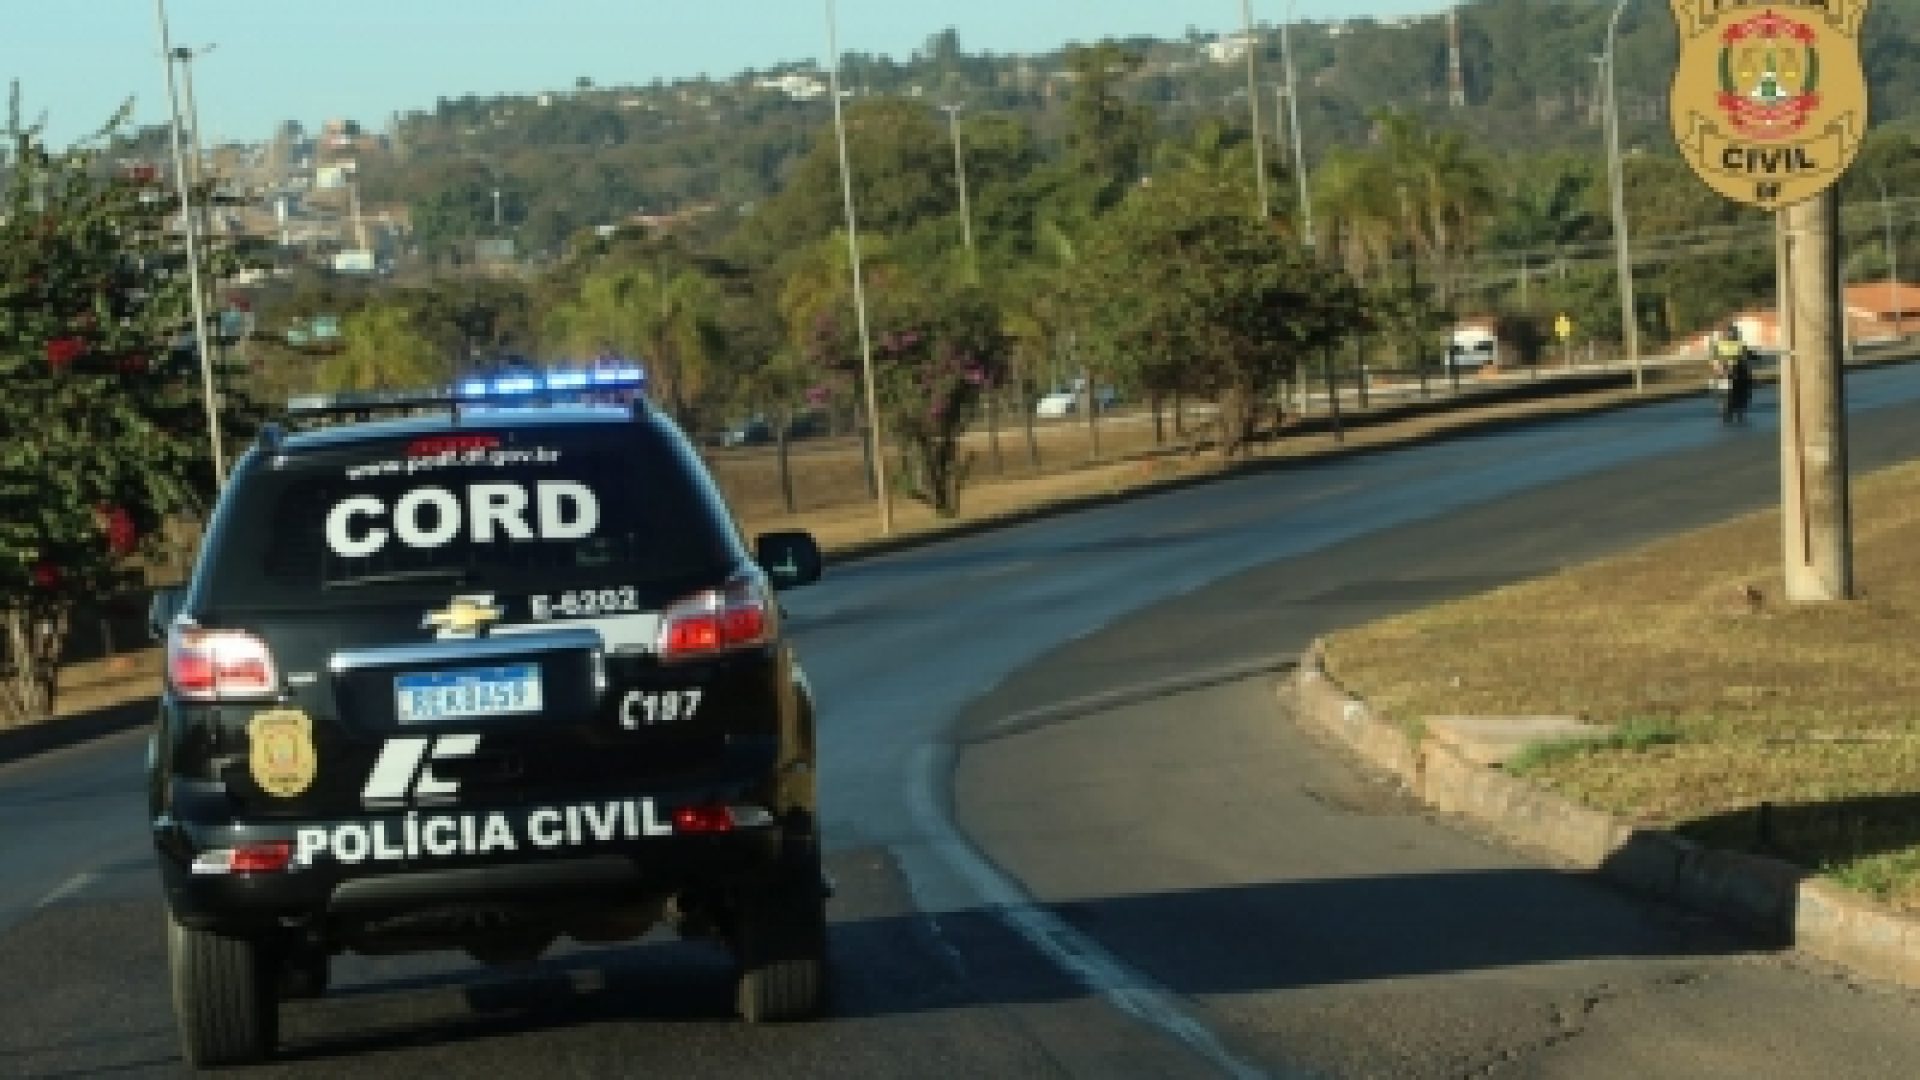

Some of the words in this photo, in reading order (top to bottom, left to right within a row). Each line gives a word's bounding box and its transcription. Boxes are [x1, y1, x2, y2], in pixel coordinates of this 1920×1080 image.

[325, 480, 600, 557] CORD
[296, 810, 519, 866] POLÍCIA
[527, 796, 672, 848] CIVIL
